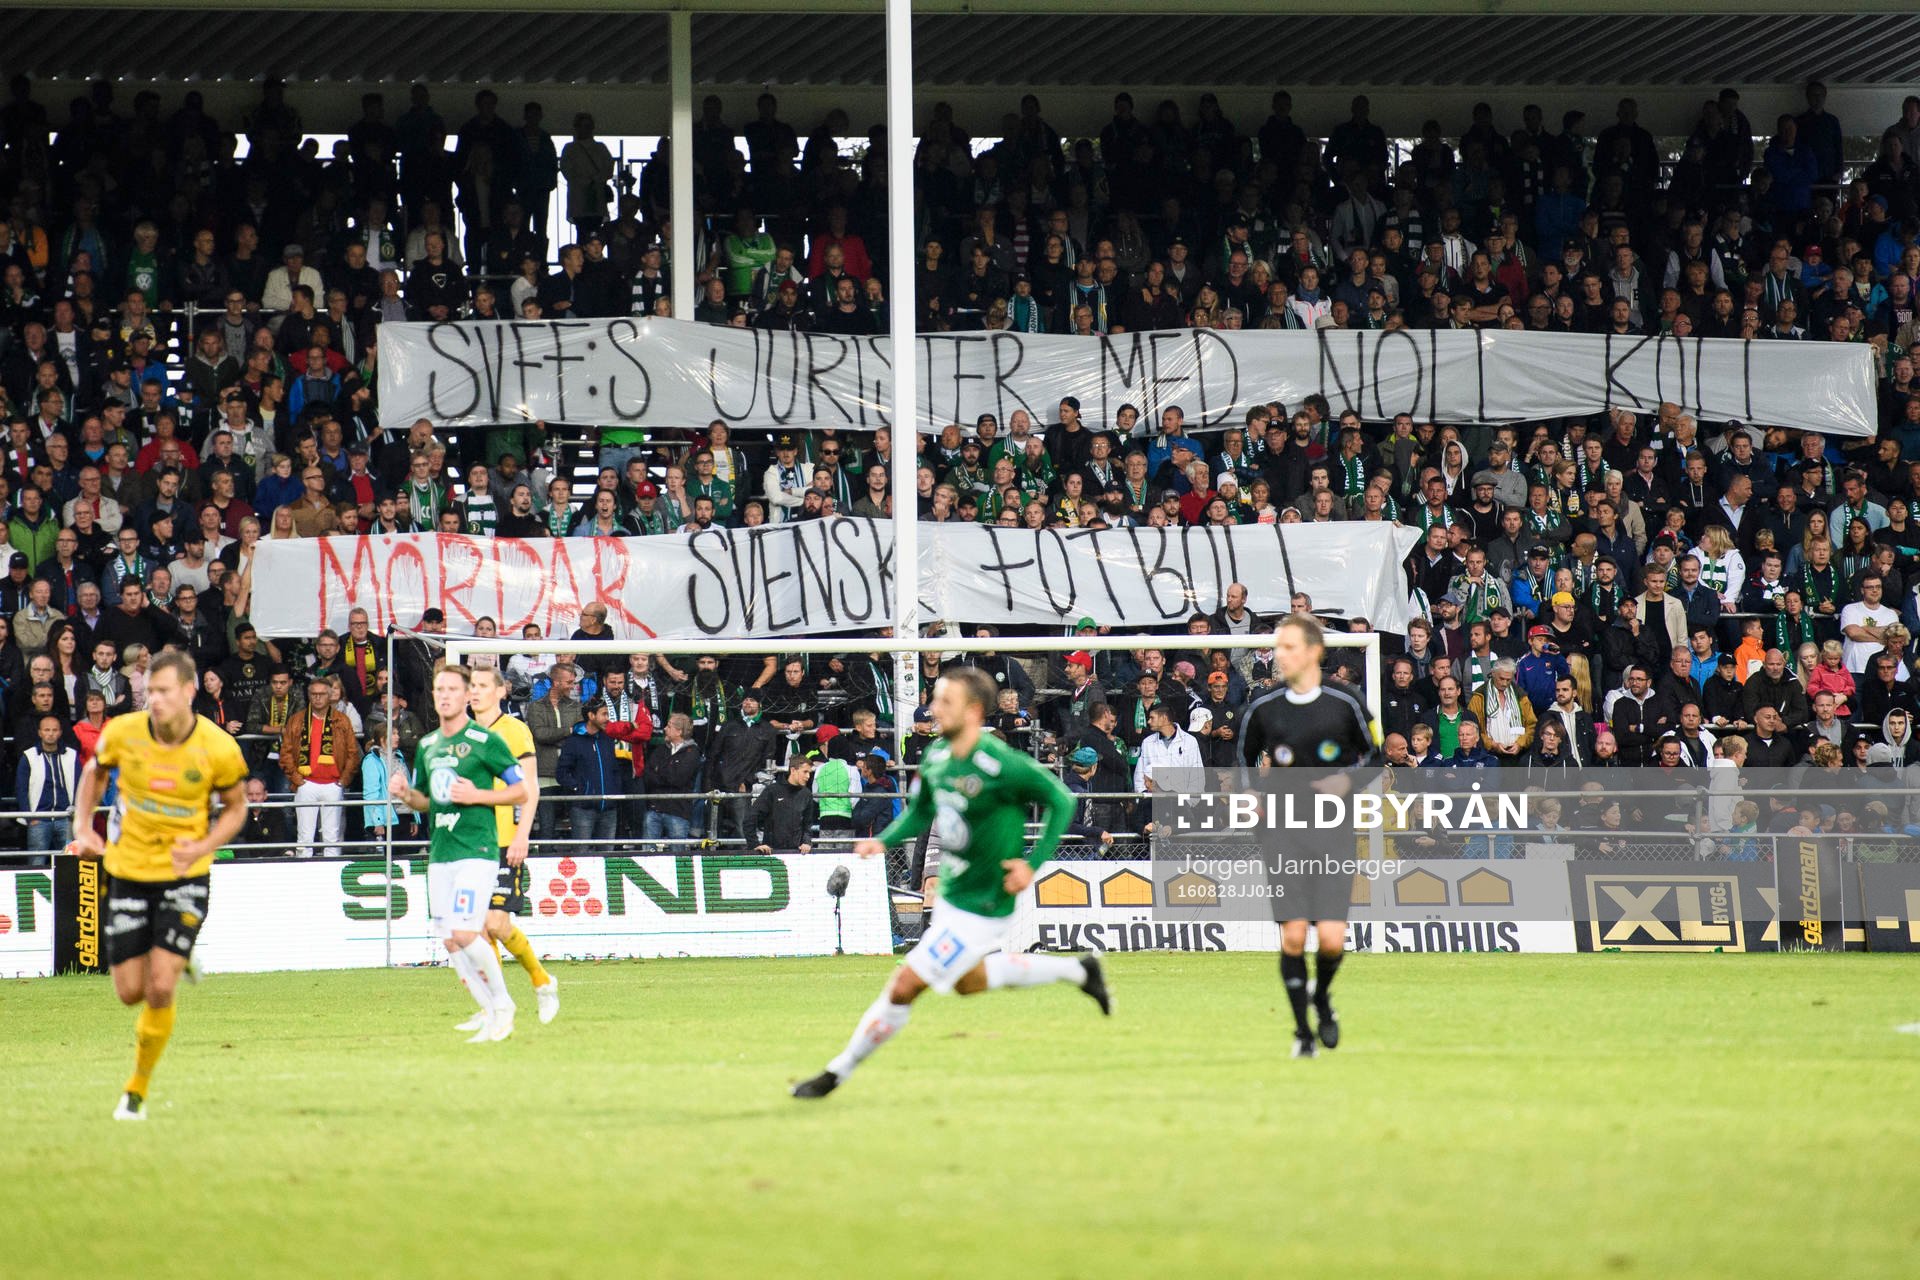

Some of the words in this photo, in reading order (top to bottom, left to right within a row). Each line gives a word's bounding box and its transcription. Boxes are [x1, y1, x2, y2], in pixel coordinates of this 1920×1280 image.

[1100, 328, 1238, 434] MED
[1317, 328, 1528, 422] NOLL
[318, 532, 657, 639] MÖRDAR
[688, 512, 936, 635] SVENSK
[75, 860, 98, 968] gårdsman
[1037, 916, 1227, 952] EKSJÖHUS
[1344, 915, 1521, 953] KSJÖHUS
[1600, 885, 1732, 942] XL
[1799, 841, 1823, 945] gårdsman
